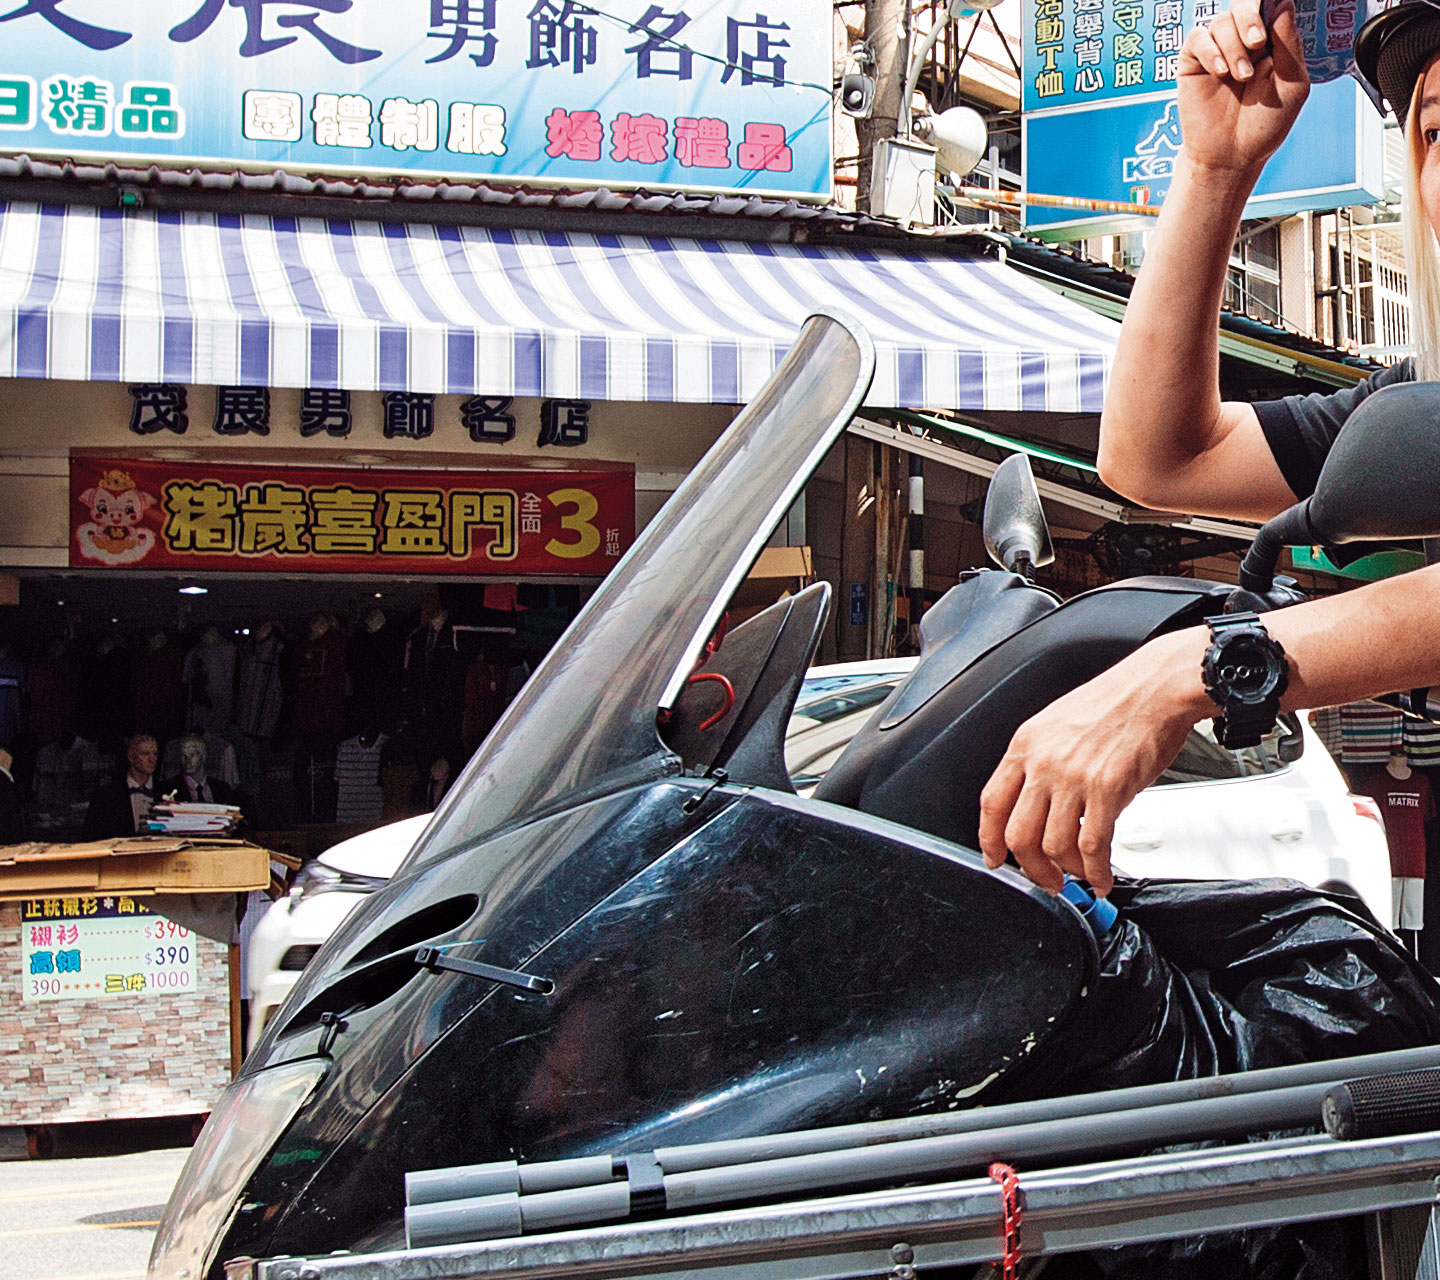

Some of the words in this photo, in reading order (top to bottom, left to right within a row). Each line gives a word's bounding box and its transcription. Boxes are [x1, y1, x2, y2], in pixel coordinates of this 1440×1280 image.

[243, 90, 507, 157] 團體制服
[546, 108, 793, 173] 婚嫁禮品
[1122, 155, 1176, 183] Ka
[128, 384, 591, 447] 茂展男飾名店
[521, 491, 542, 535] 全面
[545, 488, 600, 559] 3
[606, 526, 621, 557] 折起
[1388, 797, 1420, 808] MATRIX
[30, 923, 80, 947] 襯衫
[144, 945, 190, 966] $390
[30, 978, 61, 996] 390
[105, 973, 147, 994] 三件
[150, 970, 190, 989] 1000
